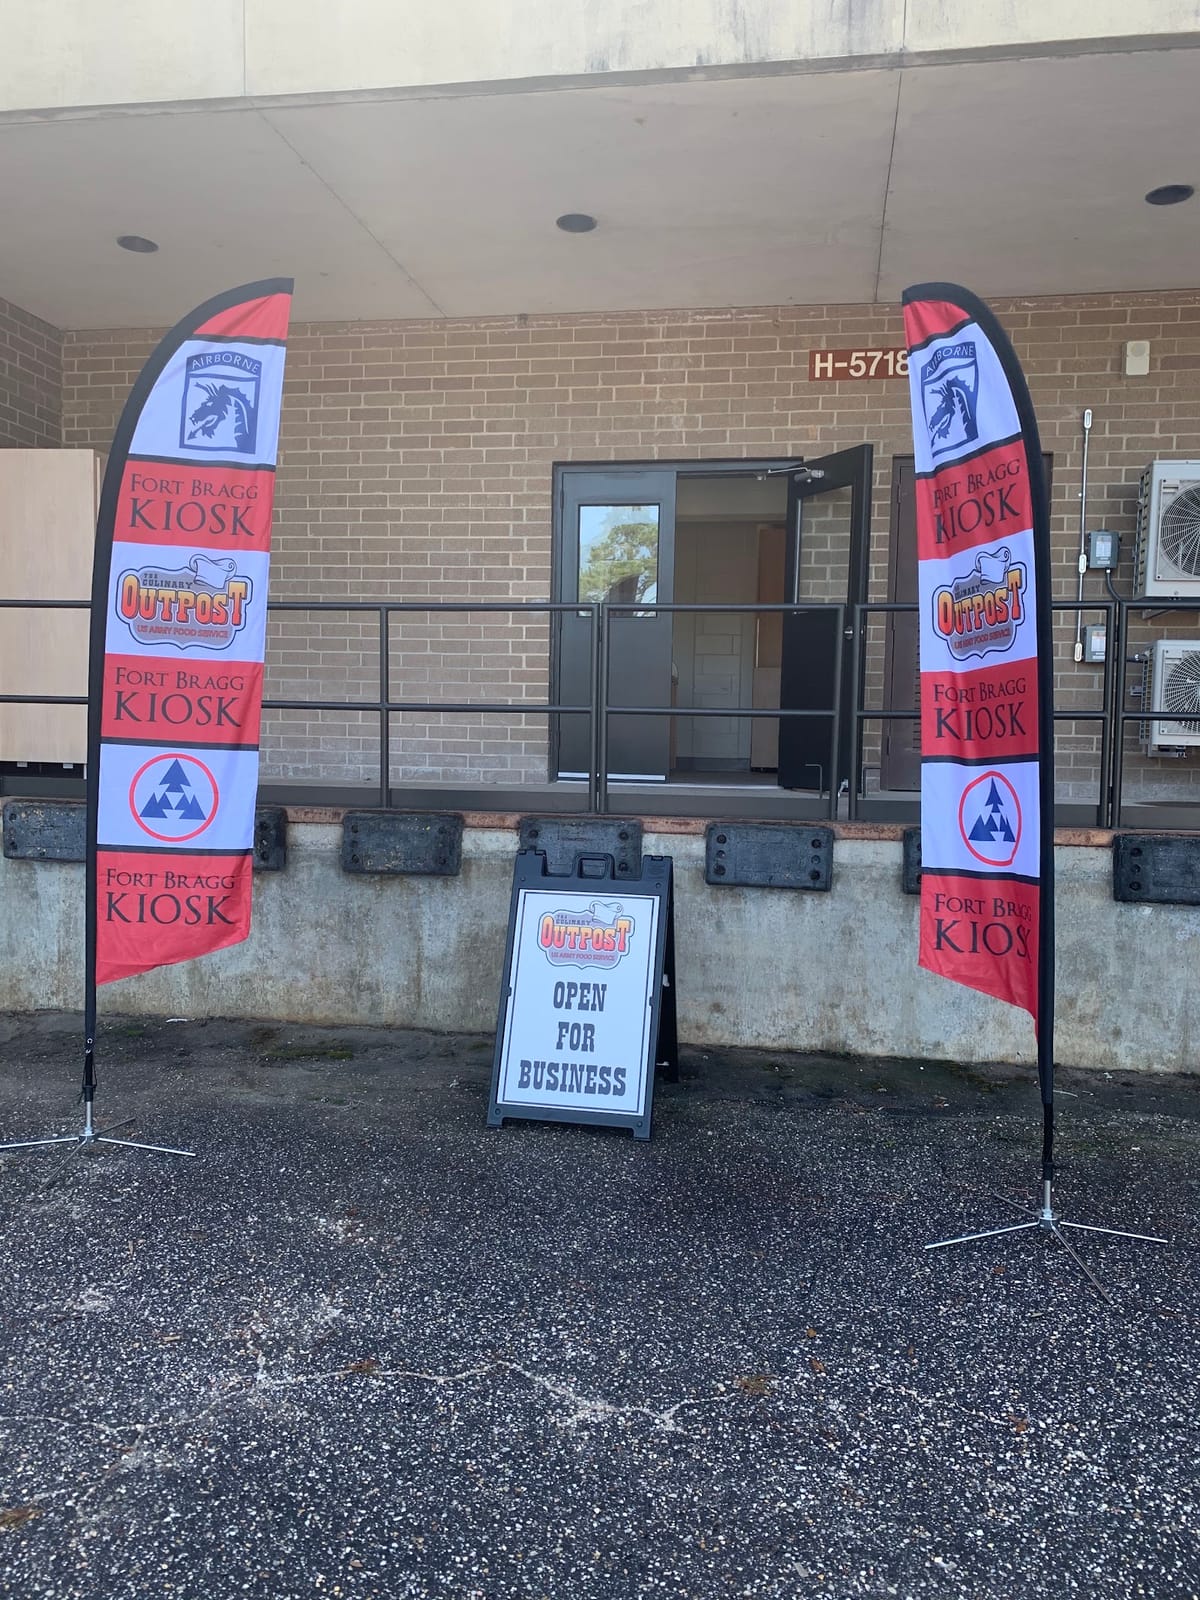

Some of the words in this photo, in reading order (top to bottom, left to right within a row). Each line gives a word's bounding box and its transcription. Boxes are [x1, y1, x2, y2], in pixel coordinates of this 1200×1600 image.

[191, 353, 260, 374] AIRBORNE
[815, 350, 908, 378] H-5718
[925, 345, 975, 376] AIRBORNE
[131, 473, 184, 495] FORT
[191, 479, 258, 500] BRAGG
[967, 459, 1020, 494] BRAGG
[128, 497, 255, 536] KIOSK
[935, 483, 1021, 544] KIOSK
[142, 579, 193, 589] CULINARY
[121, 574, 248, 626] OUTPOST
[938, 568, 1022, 636] OUTPOST
[137, 624, 148, 633] US
[172, 627, 197, 637] FOOD
[197, 629, 229, 639] SERVICE
[115, 667, 168, 687] FORT
[176, 671, 244, 691] BRAGG
[933, 683, 976, 703] FORT
[979, 678, 1026, 701] BRAGG
[113, 690, 242, 728] KIOSK
[934, 701, 1026, 741] KIOSK
[106, 868, 158, 887] FORT
[164, 871, 236, 890] BRAGG
[105, 891, 236, 926] KIOSK
[934, 893, 986, 915] FORT
[541, 915, 631, 952] OUTPOST
[553, 981, 607, 1012] OPEN
[555, 1021, 595, 1052] FOR
[518, 1059, 627, 1097] BUSINESS
